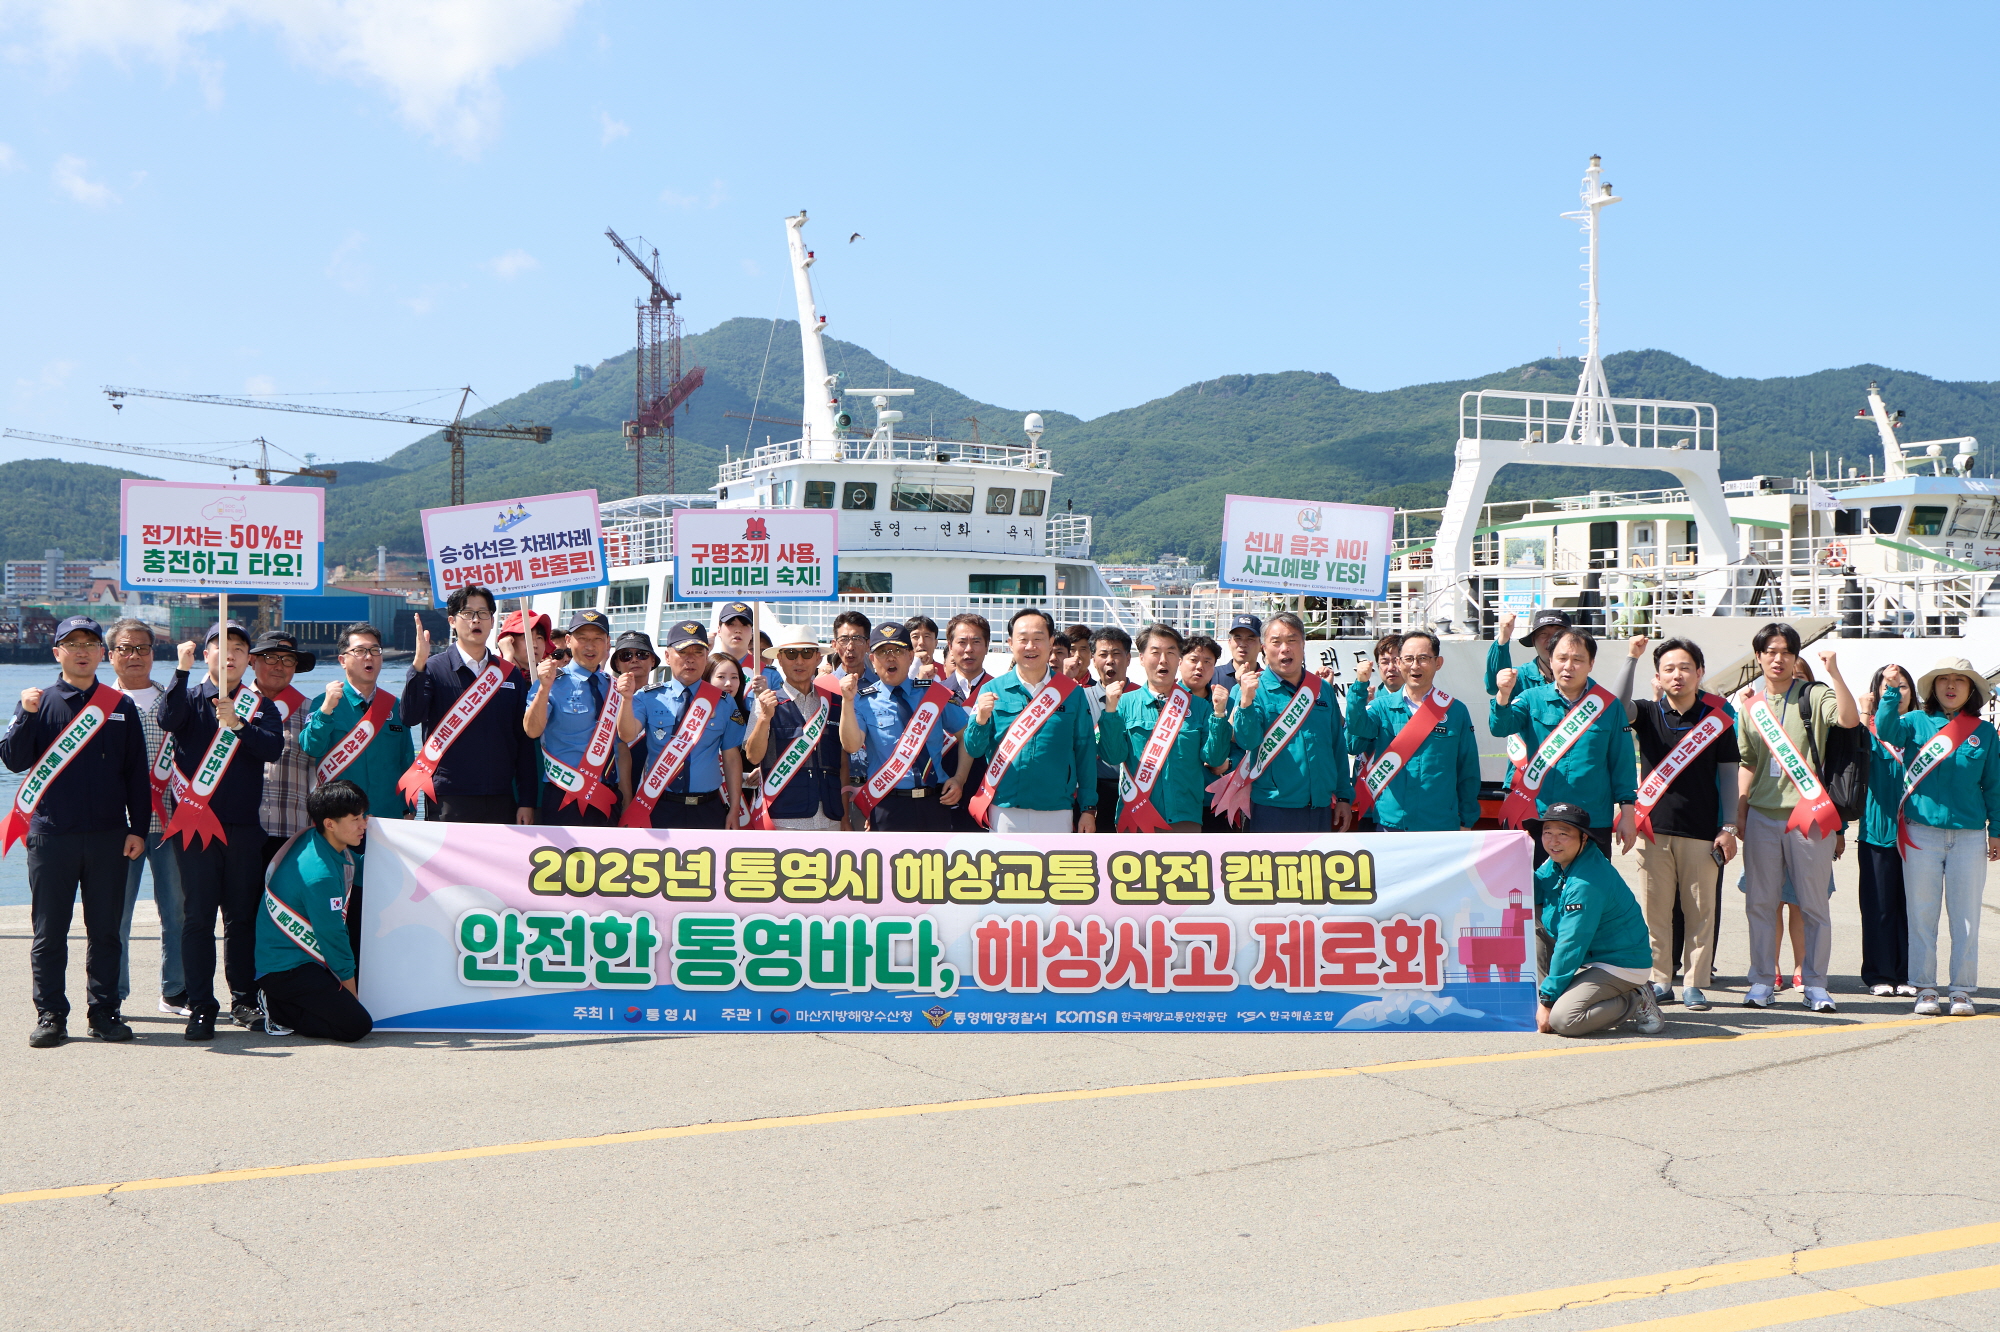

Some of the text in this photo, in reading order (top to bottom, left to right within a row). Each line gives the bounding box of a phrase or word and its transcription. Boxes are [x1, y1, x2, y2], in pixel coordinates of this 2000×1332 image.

[142, 524, 303, 549] 전기차는 50%만
[439, 528, 592, 564] 승·하선은 차례차례
[870, 521, 1033, 540] 통영 연화 욕지
[1244, 531, 1369, 561] 선내 음주 NO!
[143, 549, 303, 577] 충전하고 타요!
[442, 559, 524, 590] 안전하게
[529, 550, 596, 580] 한줄로!
[691, 543, 821, 564] 구명조끼 사용,
[1242, 555, 1320, 580] 사고예방
[1325, 561, 1367, 585] YES!
[691, 566, 821, 586] 미리미리 숙지!
[235, 693, 255, 718] 안전
[429, 671, 498, 753] 해상사고 제로화
[1282, 693, 1310, 729] 안전한
[1563, 700, 1598, 735] 안전한
[324, 728, 368, 774] 해상사고
[591, 717, 614, 758] 제로화
[648, 705, 707, 791] 해상사고 제로화
[768, 703, 828, 788] 안전한 통영바다
[872, 709, 933, 792] 해상사고 제로화
[989, 693, 1055, 779] 해상사고 제로화
[1138, 694, 1185, 784] 해상사고 제로화
[1755, 708, 1815, 792] 안전한 통영바다
[21, 714, 98, 805] 안전한 통영바다
[198, 730, 237, 787] 통영바다
[1527, 734, 1567, 783] 통영바다
[1643, 721, 1717, 799] 해상사고 제로화
[1911, 742, 1945, 777] 안전한
[530, 848, 1375, 901] 2025년 통영시 해상교통 안전 캠페인
[458, 912, 1445, 993] 안전한 통영바다, 해상사고 제로화
[573, 1006, 697, 1022] 주최 통영시
[721, 1008, 913, 1024] 주관 마산지방해양수산청
[953, 1011, 1047, 1025] 통영해양경찰서
[1055, 1010, 1228, 1024] KOMSA 한국해양교통안전공단
[1269, 1010, 1334, 1023] 한국해운조합
